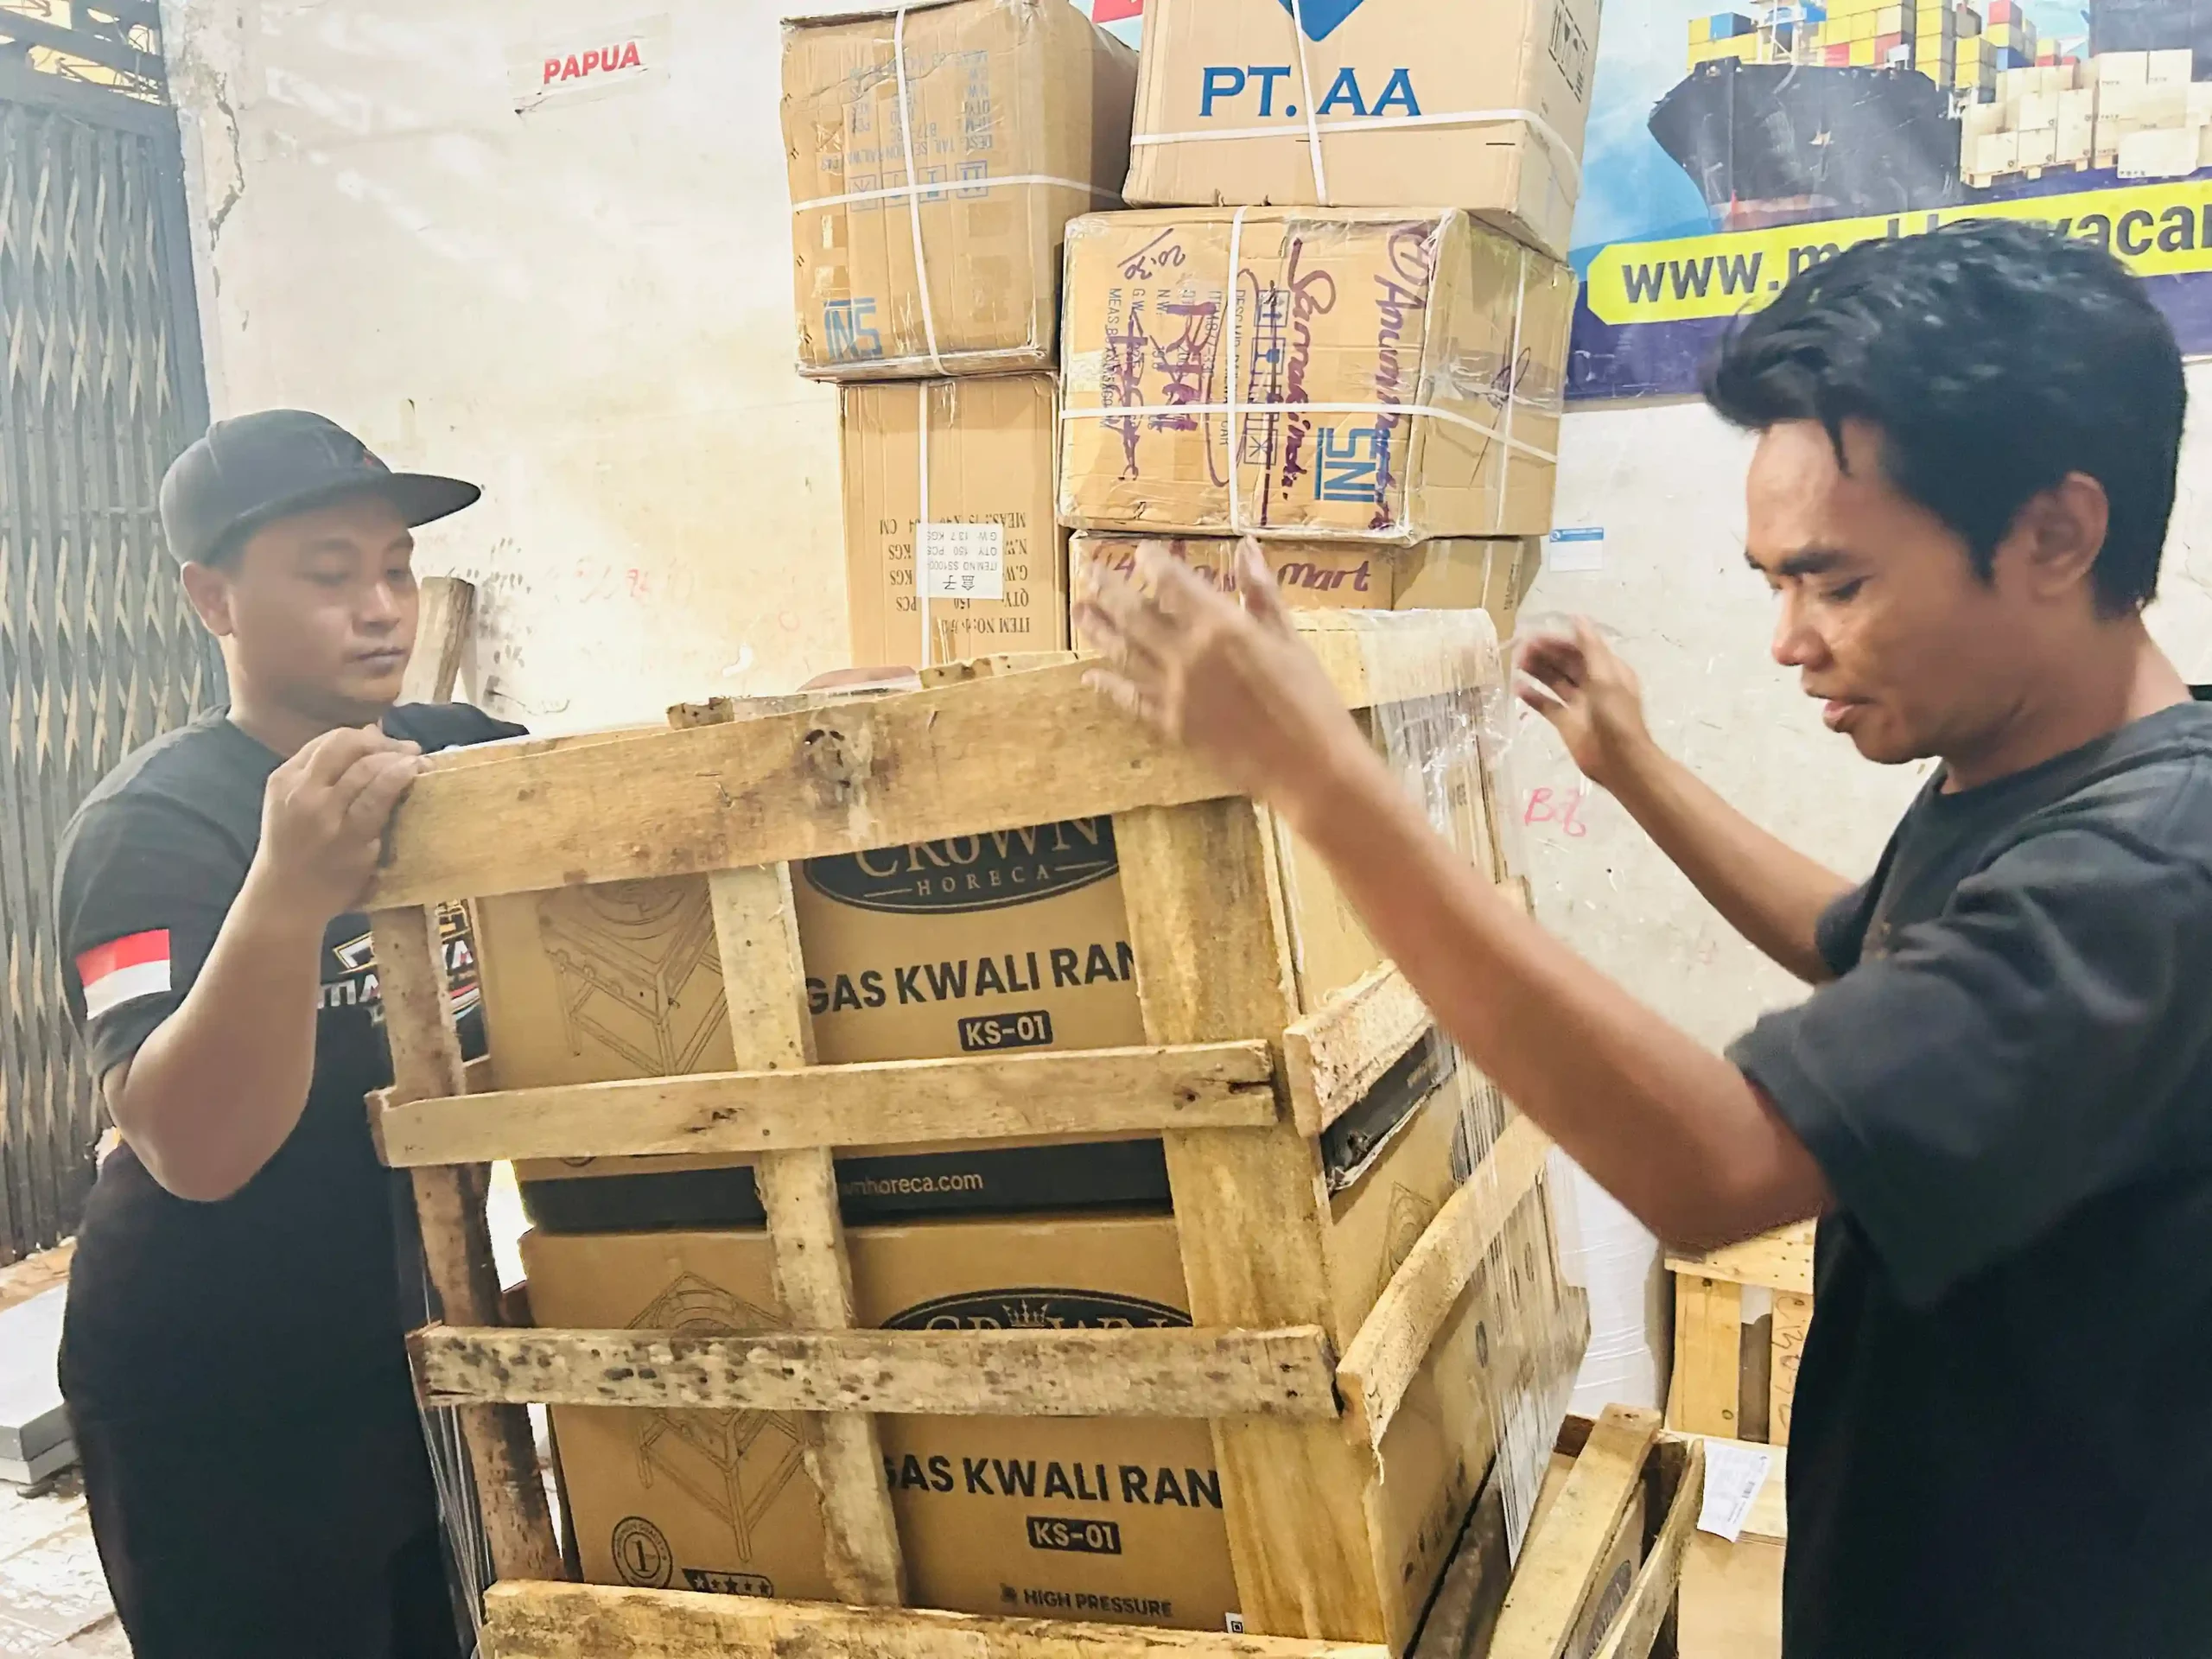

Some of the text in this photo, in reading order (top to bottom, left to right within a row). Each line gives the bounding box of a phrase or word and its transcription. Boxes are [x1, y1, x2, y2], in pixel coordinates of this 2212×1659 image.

[543, 41, 640, 85] PAPUA
[1199, 65, 1421, 118] PT. AA
[1323, 428, 1377, 503] SNI
[888, 544, 912, 560] KGS
[890, 569, 912, 586] KGS
[896, 596, 918, 612] PCS
[1000, 618, 1030, 633] ITEM
[918, 866, 1051, 897] HORECA
[805, 969, 887, 1015] GAS
[894, 951, 1041, 1005] KWALI
[966, 1015, 1046, 1046] KS-01
[963, 1457, 1109, 1502] KWALI
[1033, 1520, 1115, 1551] KS-01
[1024, 1588, 1173, 1618] HIGH PRESSURE
